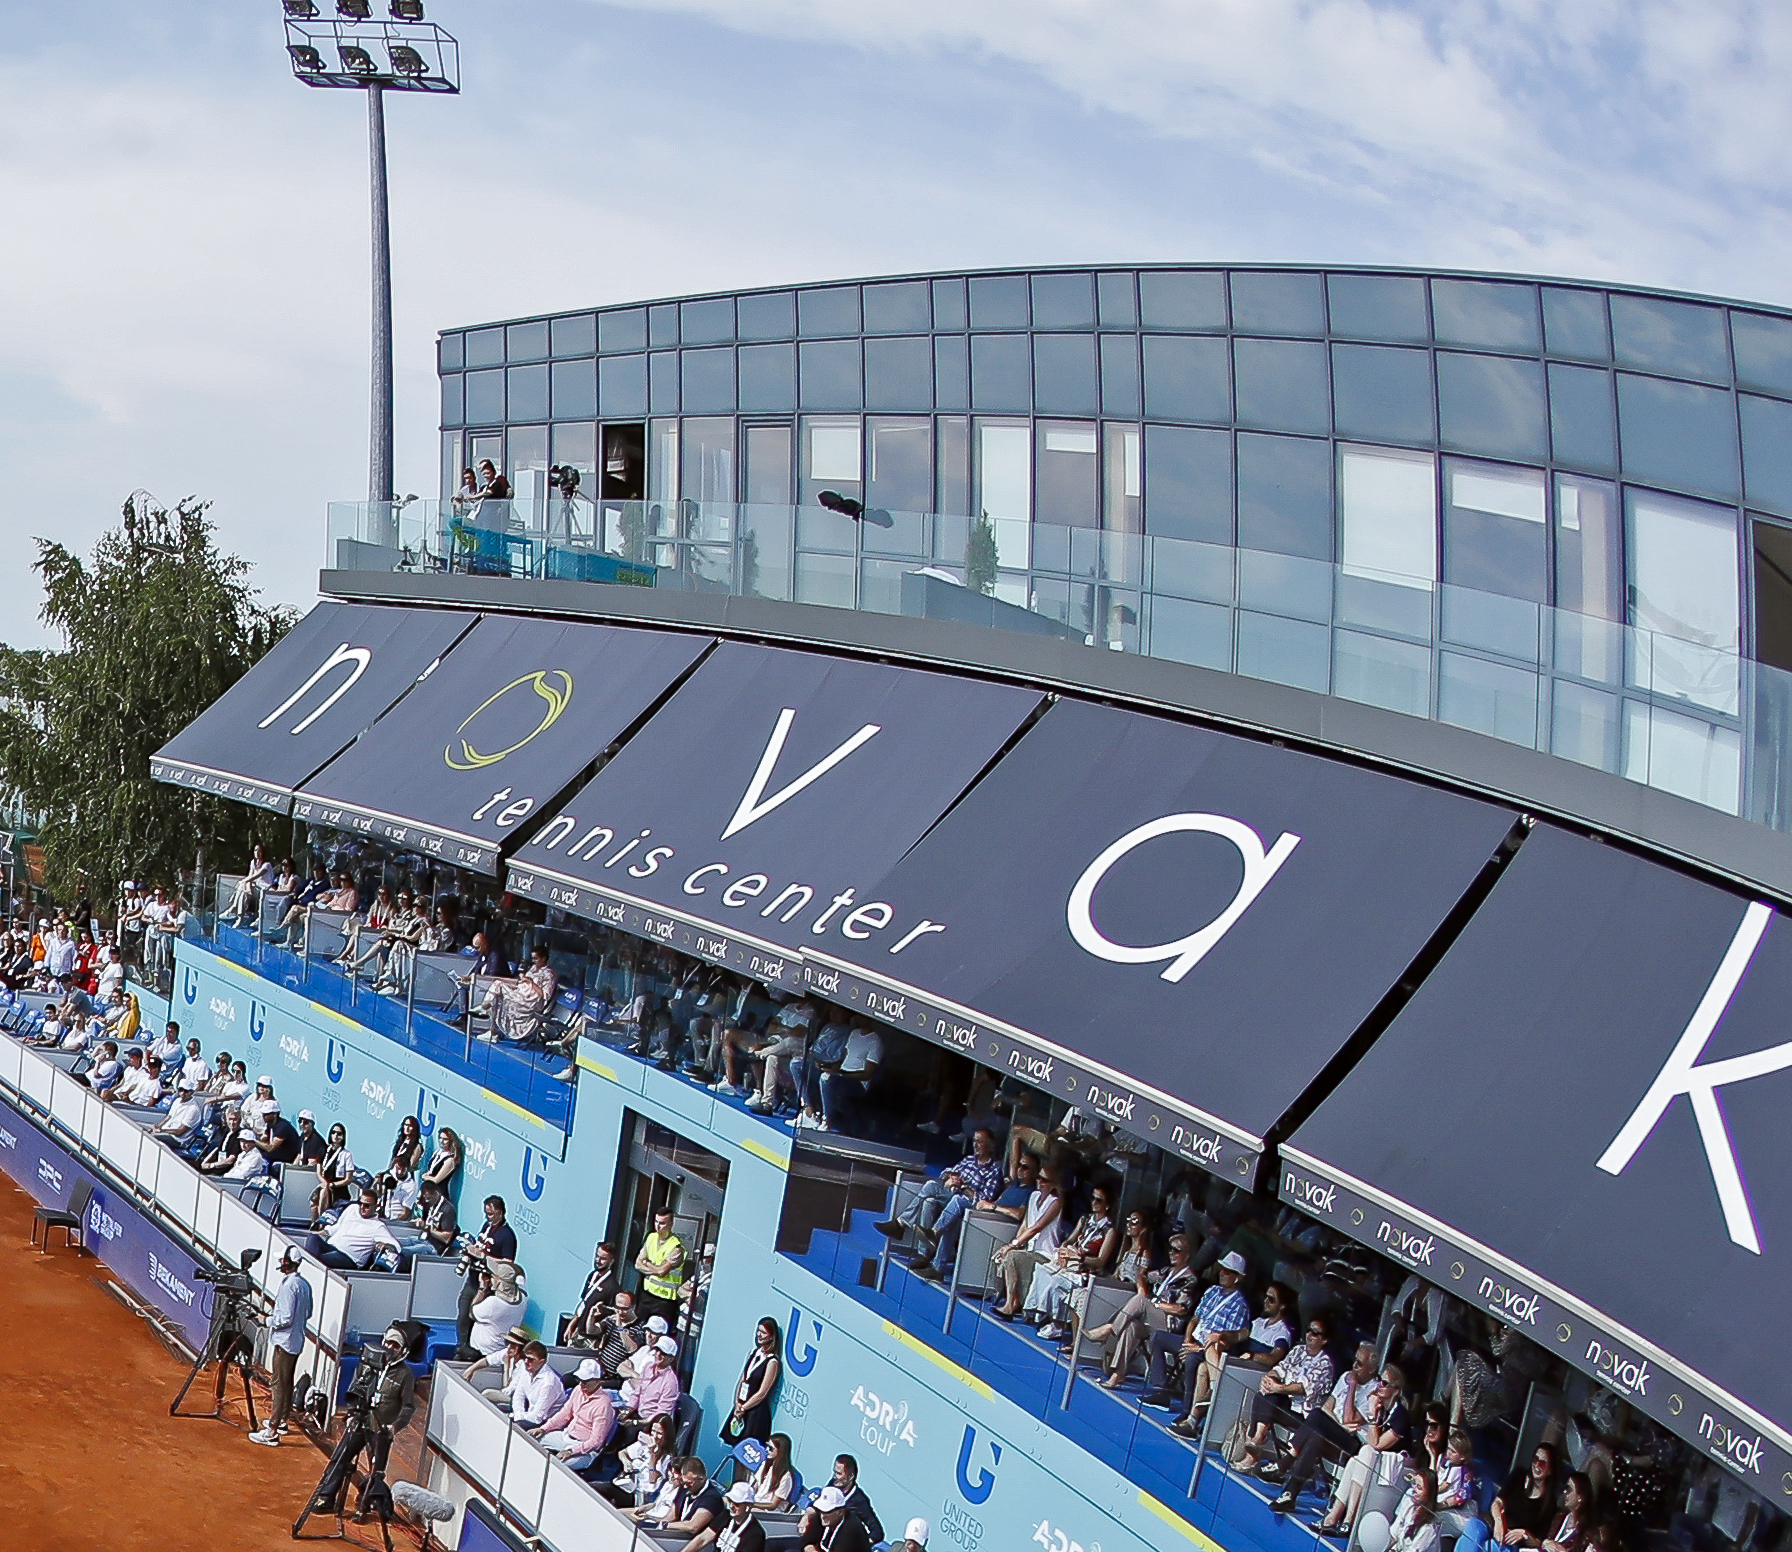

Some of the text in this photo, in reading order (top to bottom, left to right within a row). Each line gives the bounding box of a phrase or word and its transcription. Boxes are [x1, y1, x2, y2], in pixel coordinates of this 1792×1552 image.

[472, 785, 947, 956] tennis center
[803, 964, 841, 994] novak
[865, 989, 907, 1020] novak
[934, 1017, 979, 1049] novak
[1008, 1049, 1055, 1083] novak
[359, 1076, 397, 1111] ADRIA
[1086, 1084, 1136, 1121] novak
[1171, 1123, 1223, 1164] novak
[1284, 1172, 1338, 1213] novak
[1376, 1220, 1437, 1266] novak
[157, 1255, 196, 1307] BEKAMENT
[1478, 1276, 1542, 1326] novak
[1584, 1339, 1651, 1396] novak
[781, 1380, 811, 1409] NITED
[848, 1383, 919, 1448] ADRIA
[859, 1415, 898, 1458] tour
[1697, 1413, 1766, 1475] novak
[939, 1516, 979, 1552] GROUP
[942, 1498, 985, 1540] UNITED
